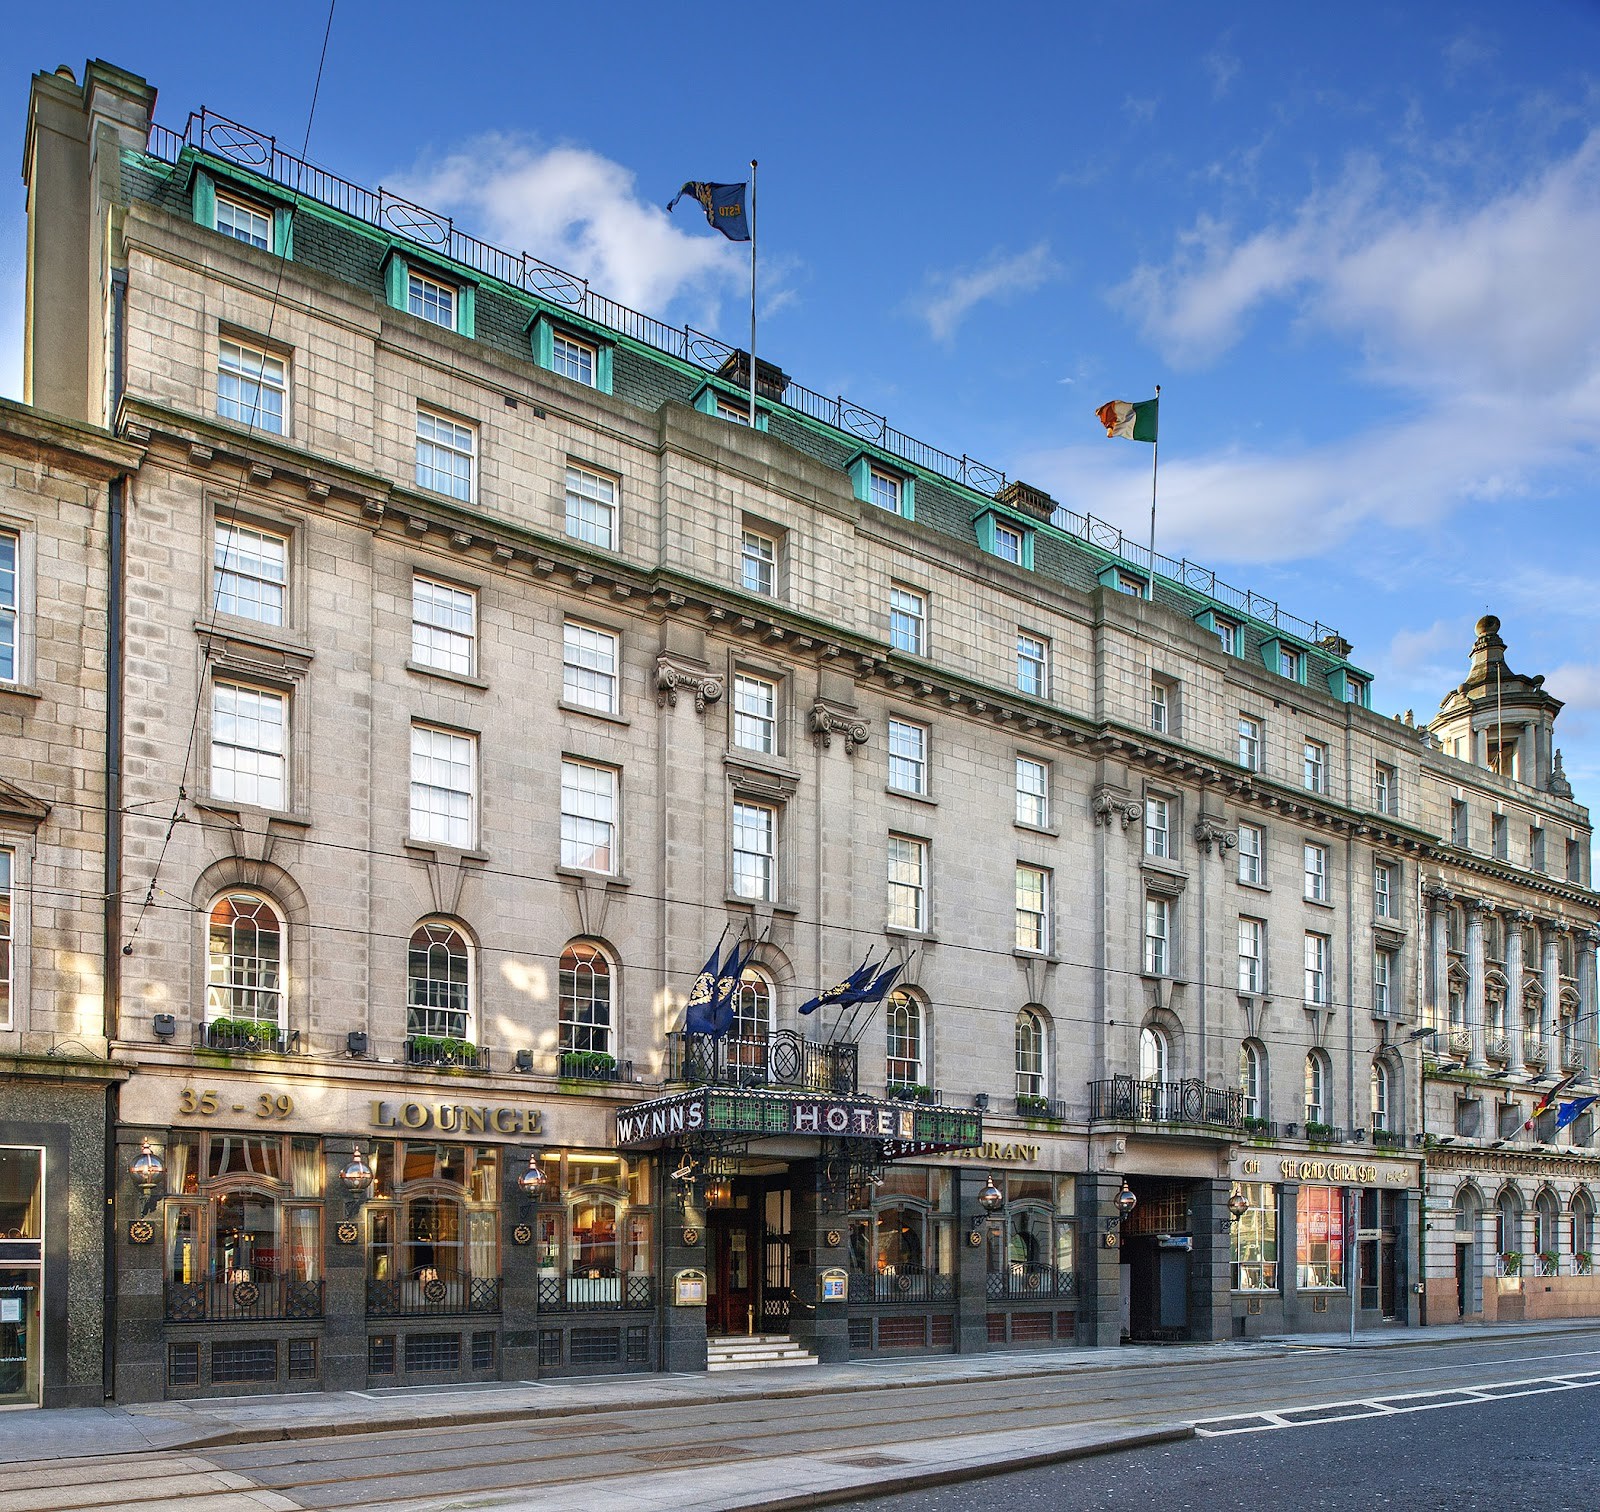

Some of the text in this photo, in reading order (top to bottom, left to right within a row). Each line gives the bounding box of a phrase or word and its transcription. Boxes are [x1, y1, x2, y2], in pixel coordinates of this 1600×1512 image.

[179, 1088, 220, 1115] 35
[256, 1093, 294, 1120] 39
[369, 1100, 543, 1134] LOUNGE
[618, 1102, 912, 1142] WYNNS HOTEL
[936, 1142, 1041, 1161] AURANT
